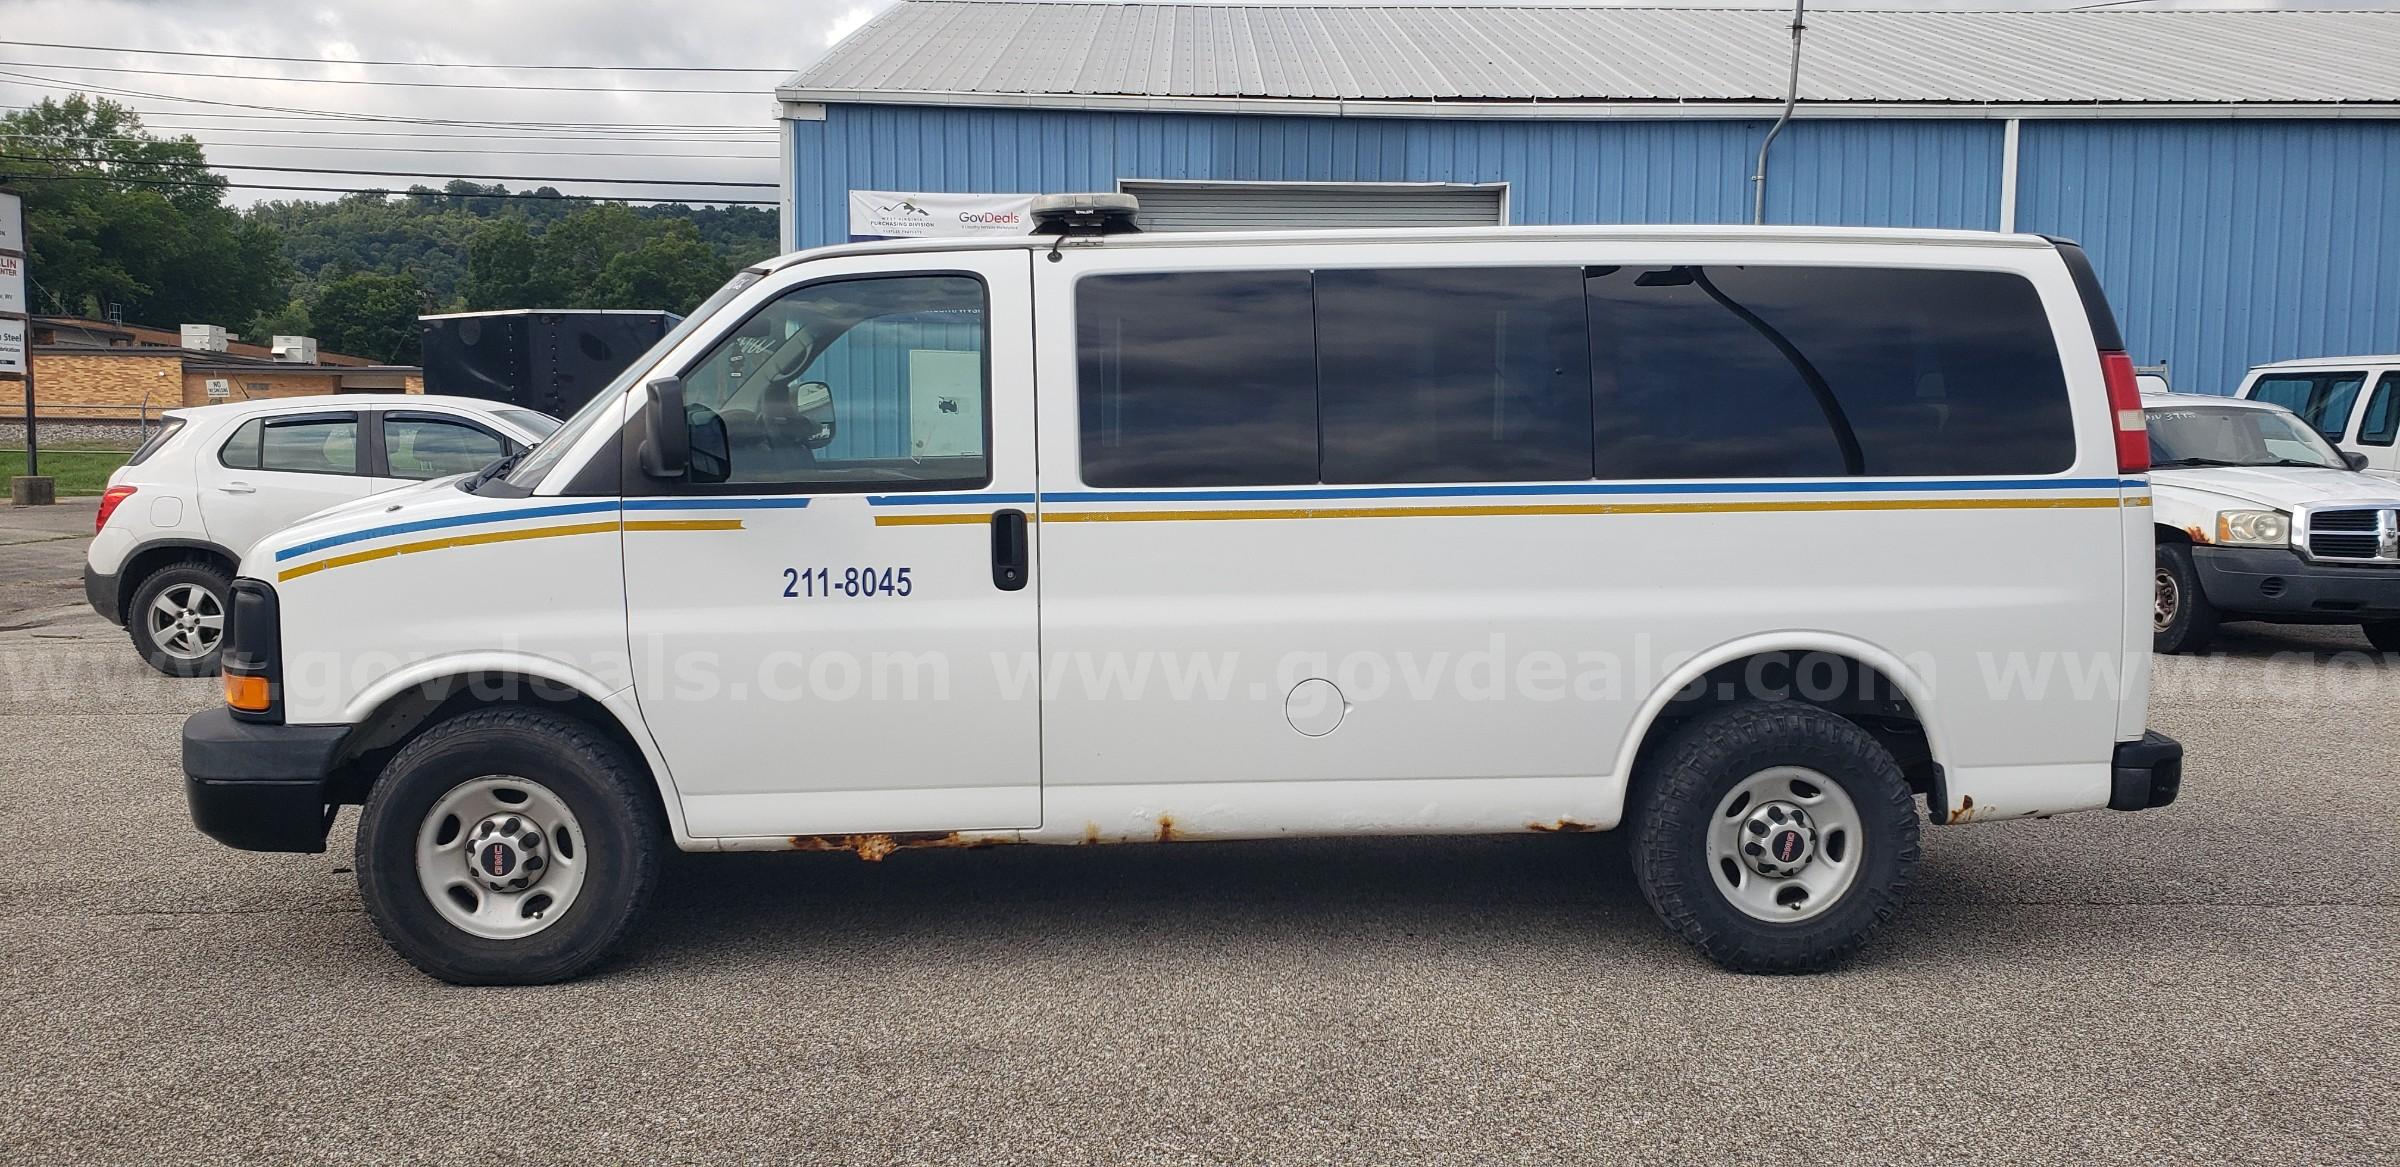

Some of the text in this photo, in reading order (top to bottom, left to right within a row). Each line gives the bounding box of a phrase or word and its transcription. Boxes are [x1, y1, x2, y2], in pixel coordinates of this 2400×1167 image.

[959, 211, 1020, 224] GovDeals
[4, 333, 21, 342] Steel
[783, 567, 912, 597] 211-8045
[494, 844, 503, 875] GMC
[1781, 831, 1796, 862] GMC
